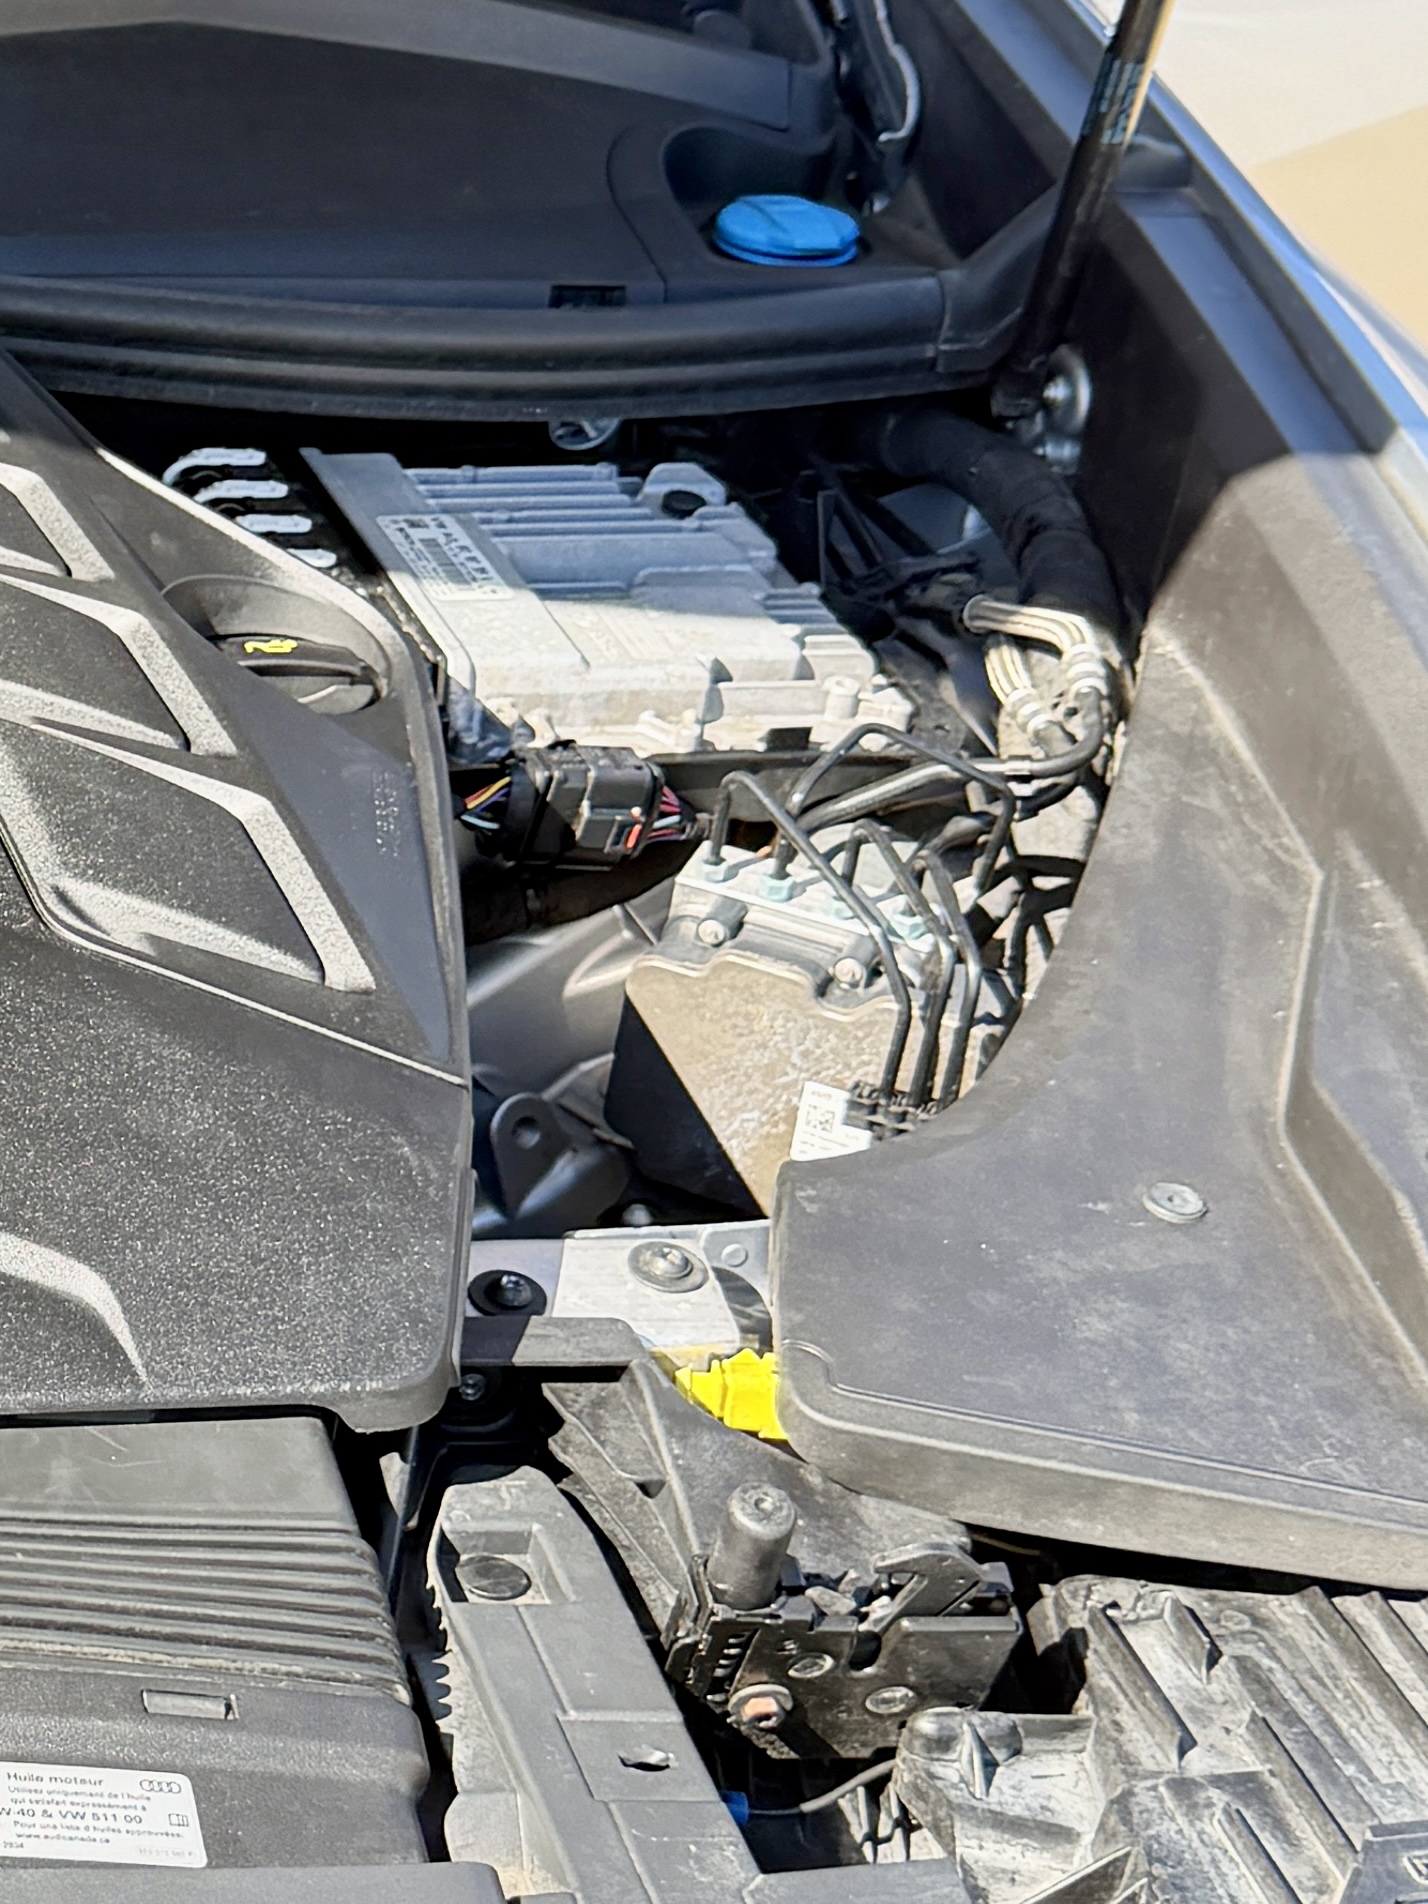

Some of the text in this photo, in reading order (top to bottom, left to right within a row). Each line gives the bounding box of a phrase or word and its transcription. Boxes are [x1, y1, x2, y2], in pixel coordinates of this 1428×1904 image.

[7, 1772, 104, 1786] Huile moteur
[58, 1810, 85, 1820] VW
[92, 1813, 117, 1822] 511
[124, 1814, 142, 1824] 00
